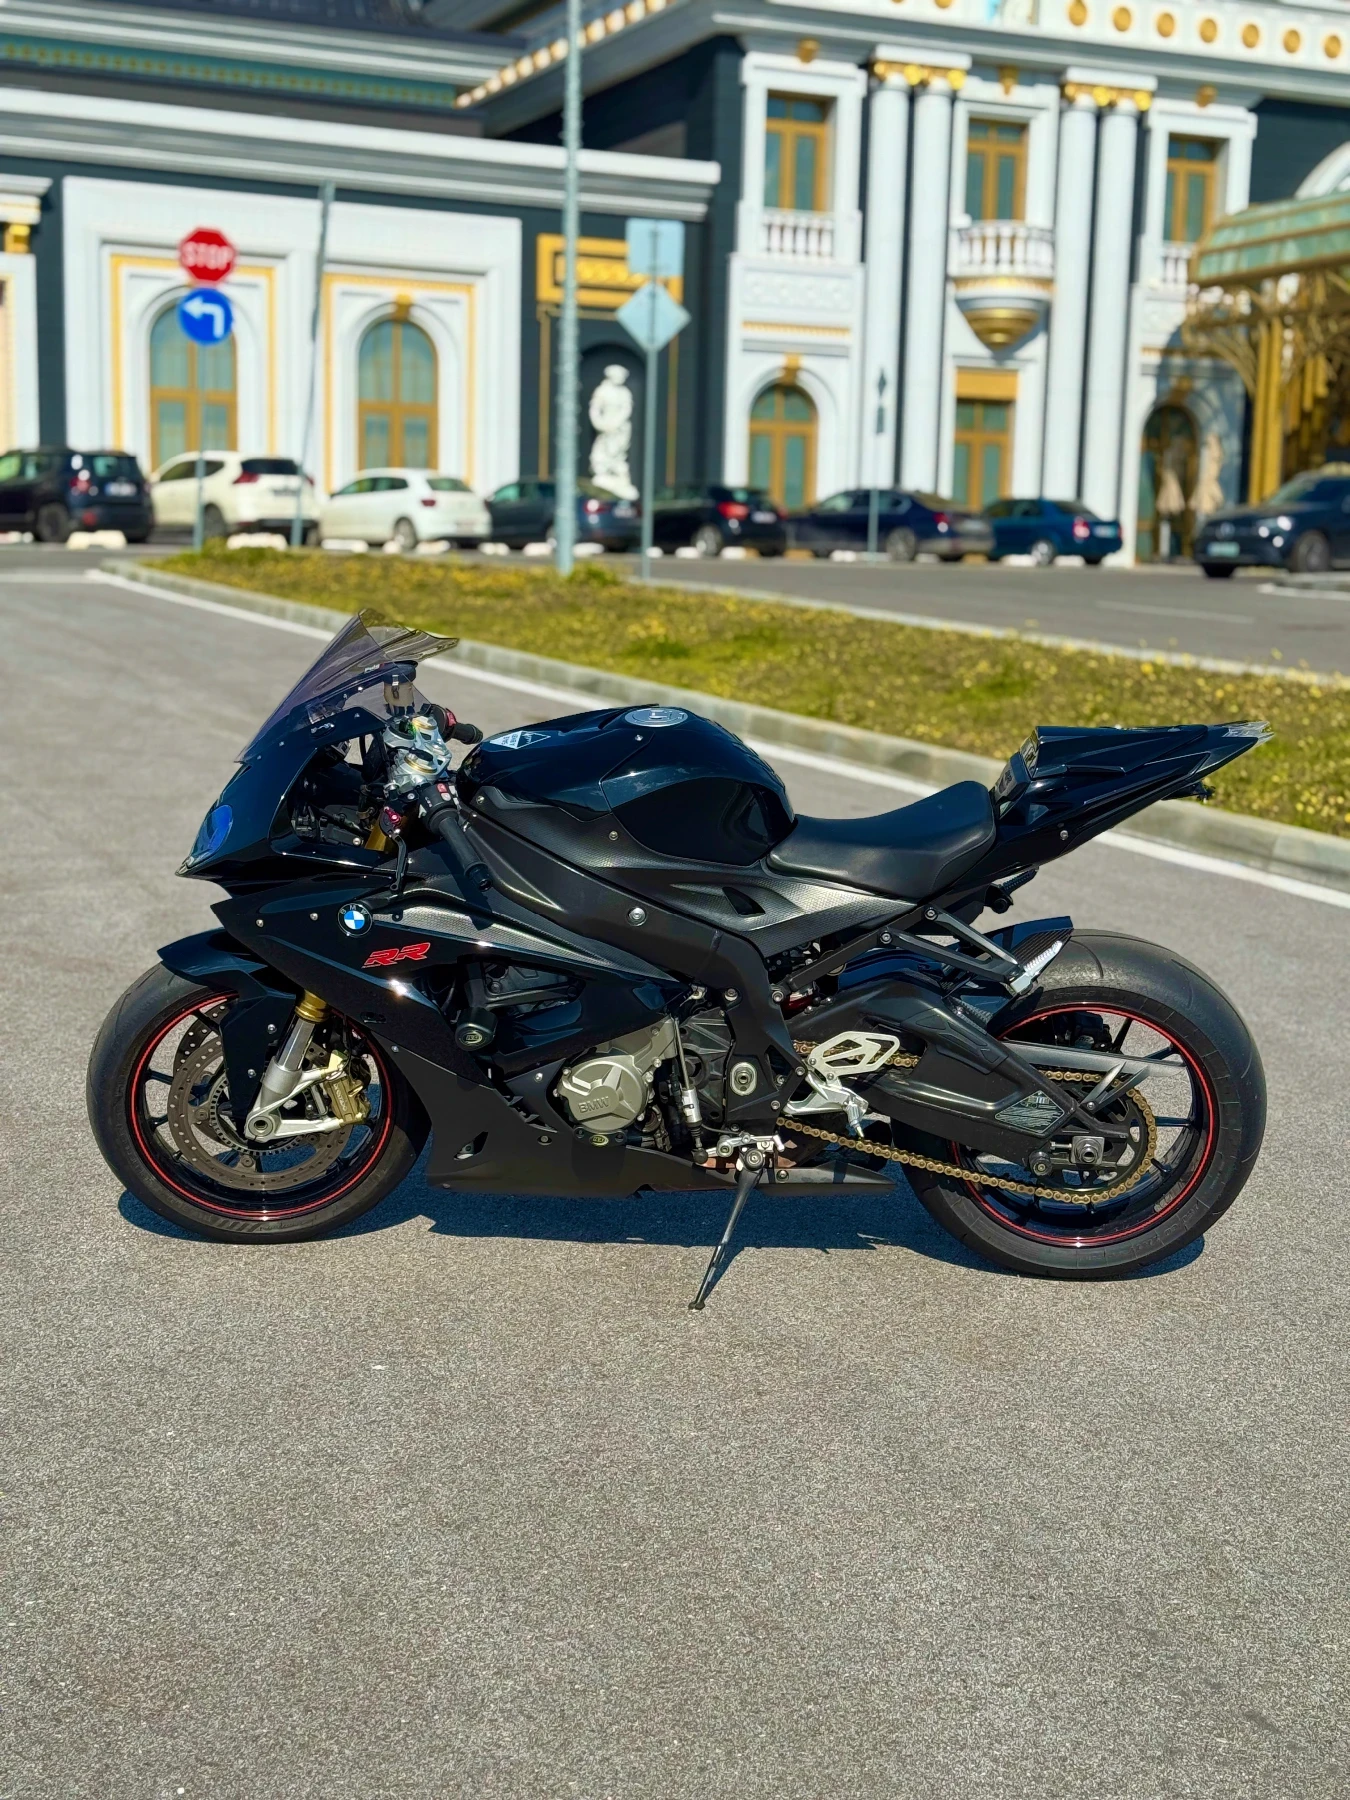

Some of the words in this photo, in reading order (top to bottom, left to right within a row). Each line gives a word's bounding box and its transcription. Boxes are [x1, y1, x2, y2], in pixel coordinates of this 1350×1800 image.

[182, 242, 233, 269] STOP
[340, 905, 369, 915] BMW
[362, 942, 431, 967] RR
[578, 1096, 610, 1113] BMW
